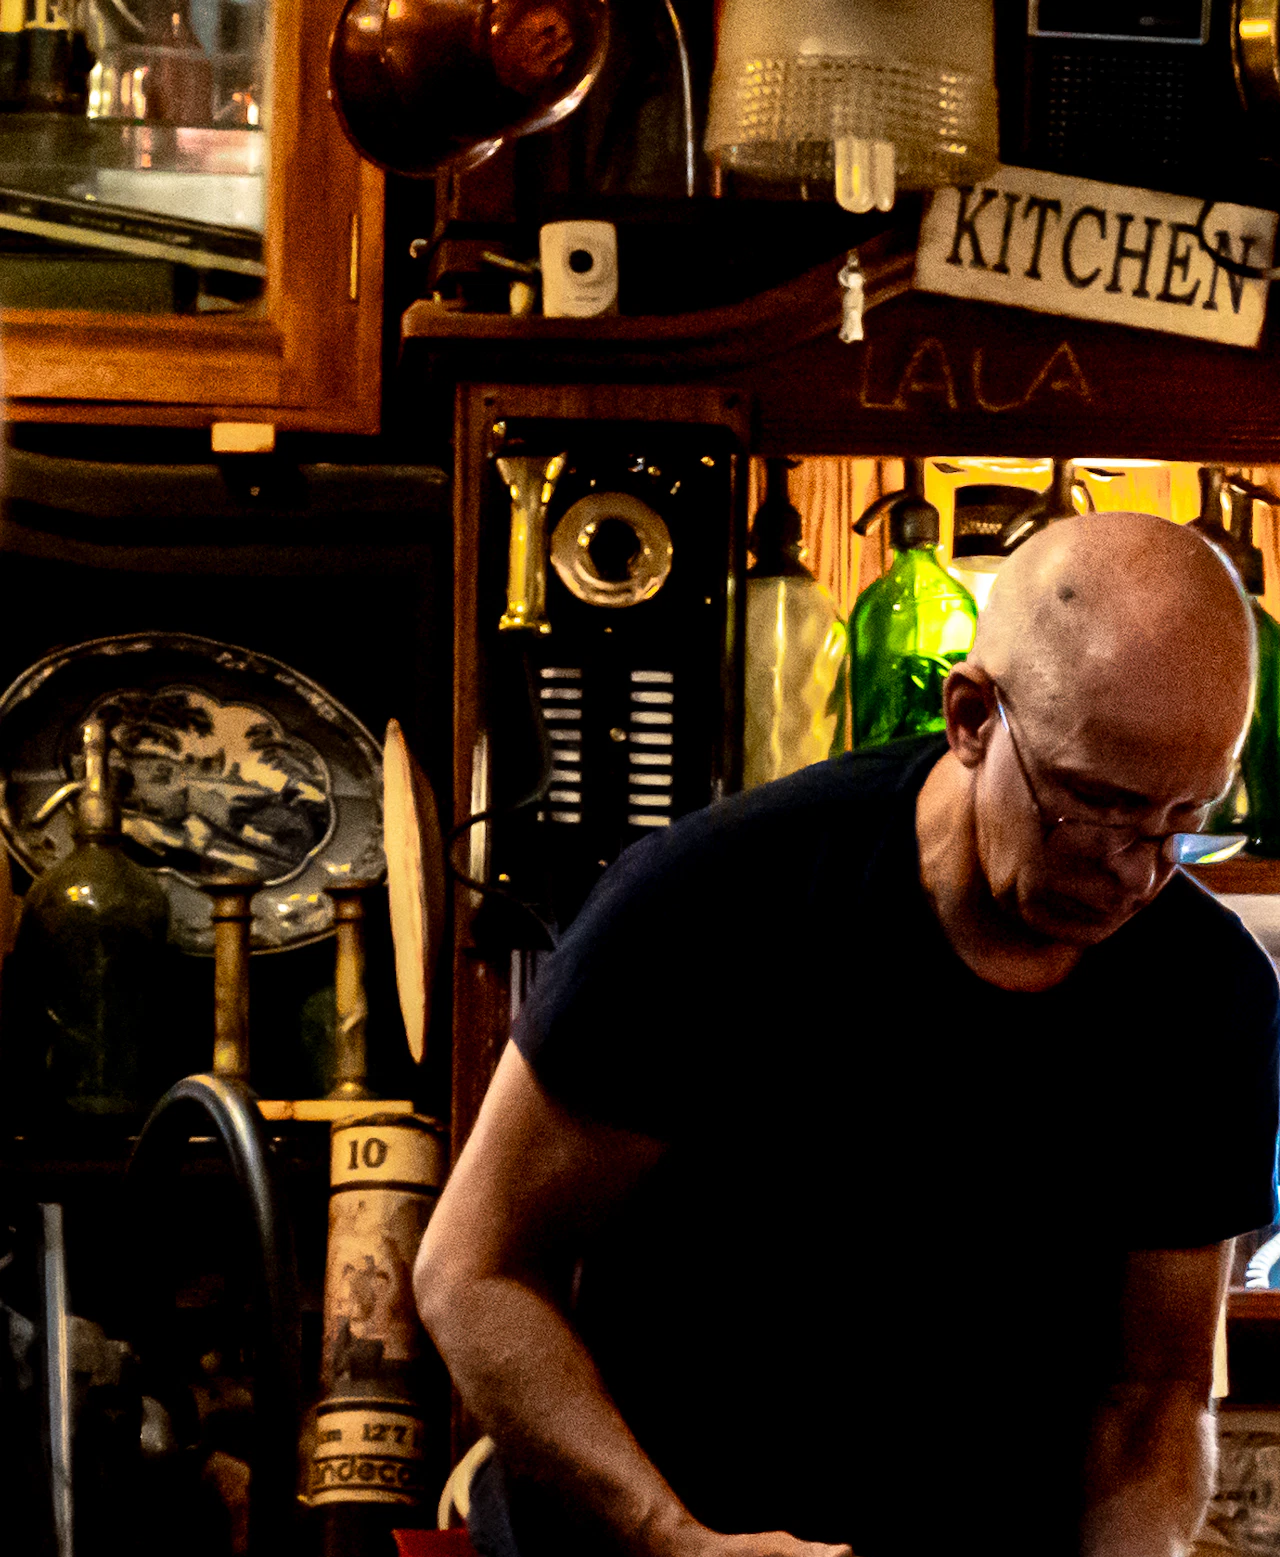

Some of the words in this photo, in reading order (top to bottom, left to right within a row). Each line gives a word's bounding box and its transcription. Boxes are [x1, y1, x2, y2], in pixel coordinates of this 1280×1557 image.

[945, 185, 1260, 314] KITCHEN
[859, 336, 1092, 412] LALA
[347, 1137, 388, 1170] 10
